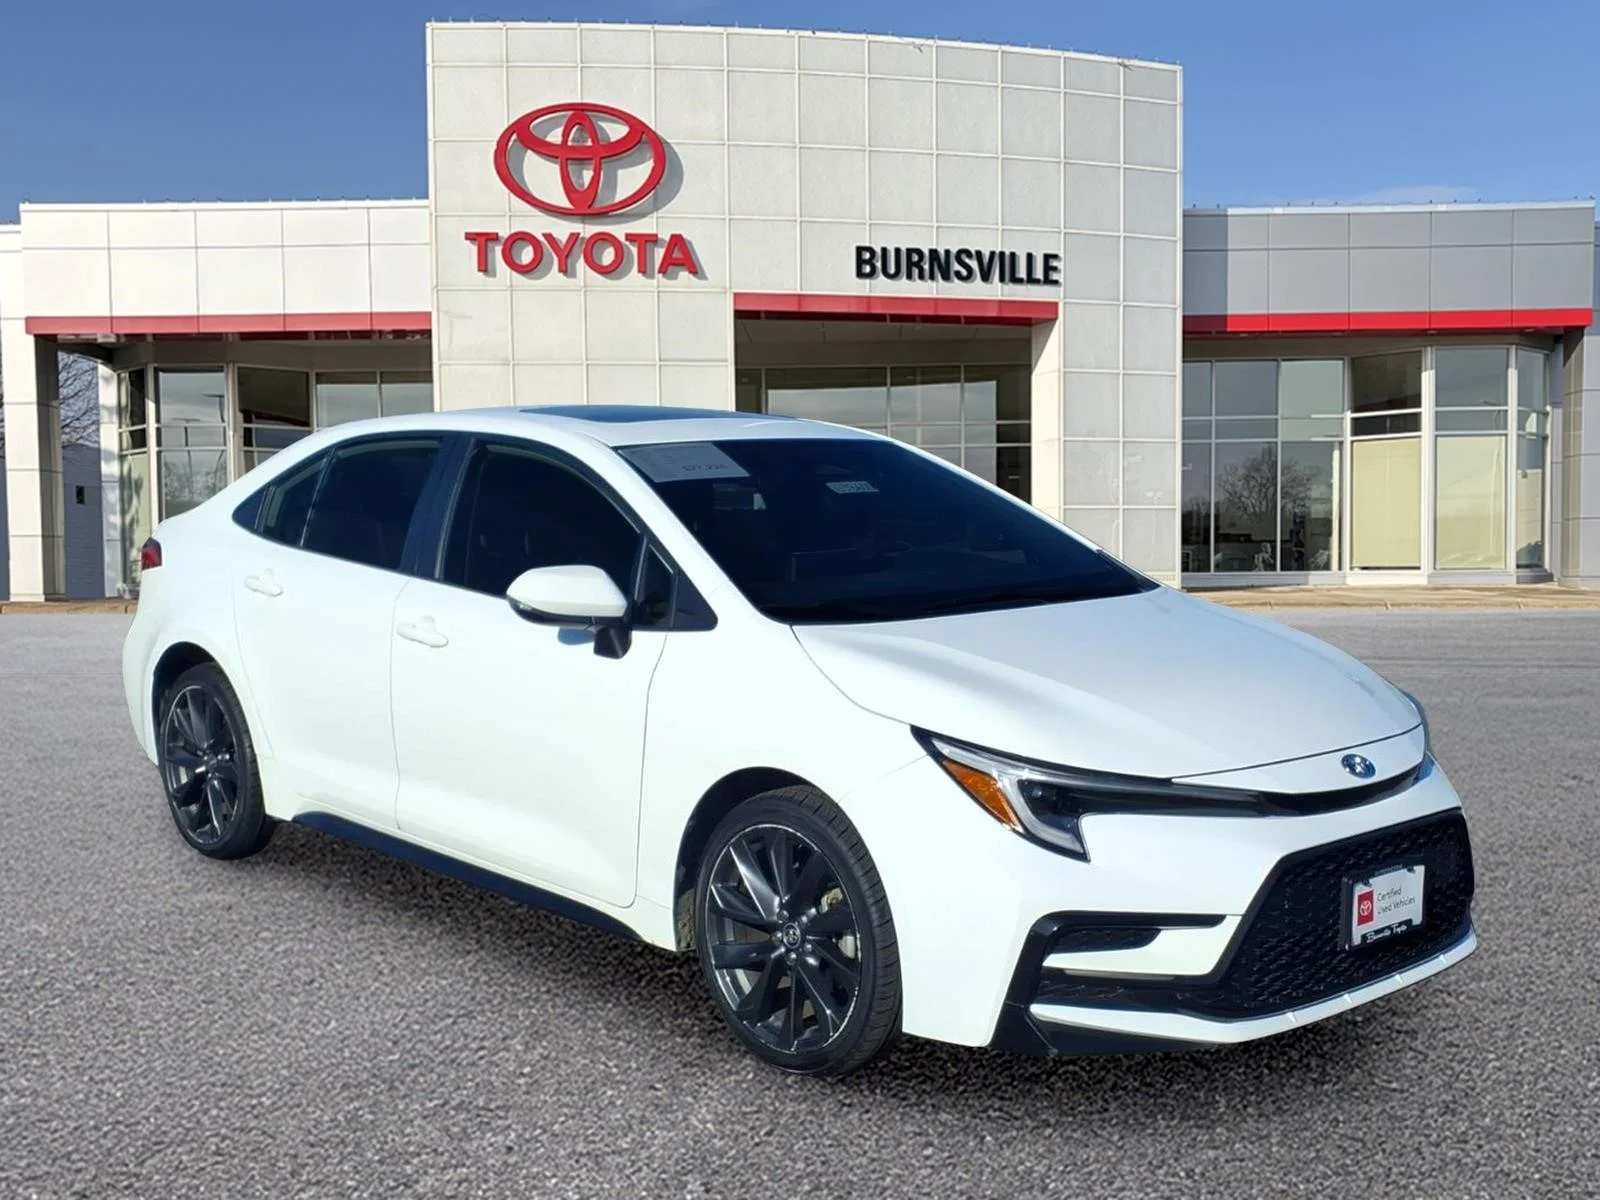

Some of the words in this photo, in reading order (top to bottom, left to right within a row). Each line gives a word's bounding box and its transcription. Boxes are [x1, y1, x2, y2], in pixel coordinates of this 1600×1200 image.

[465, 231, 700, 275] TOYOTA
[855, 245, 1060, 286] BURNSVILLE
[1377, 887, 1402, 902] Certified
[1392, 895, 1416, 909] Vehicles
